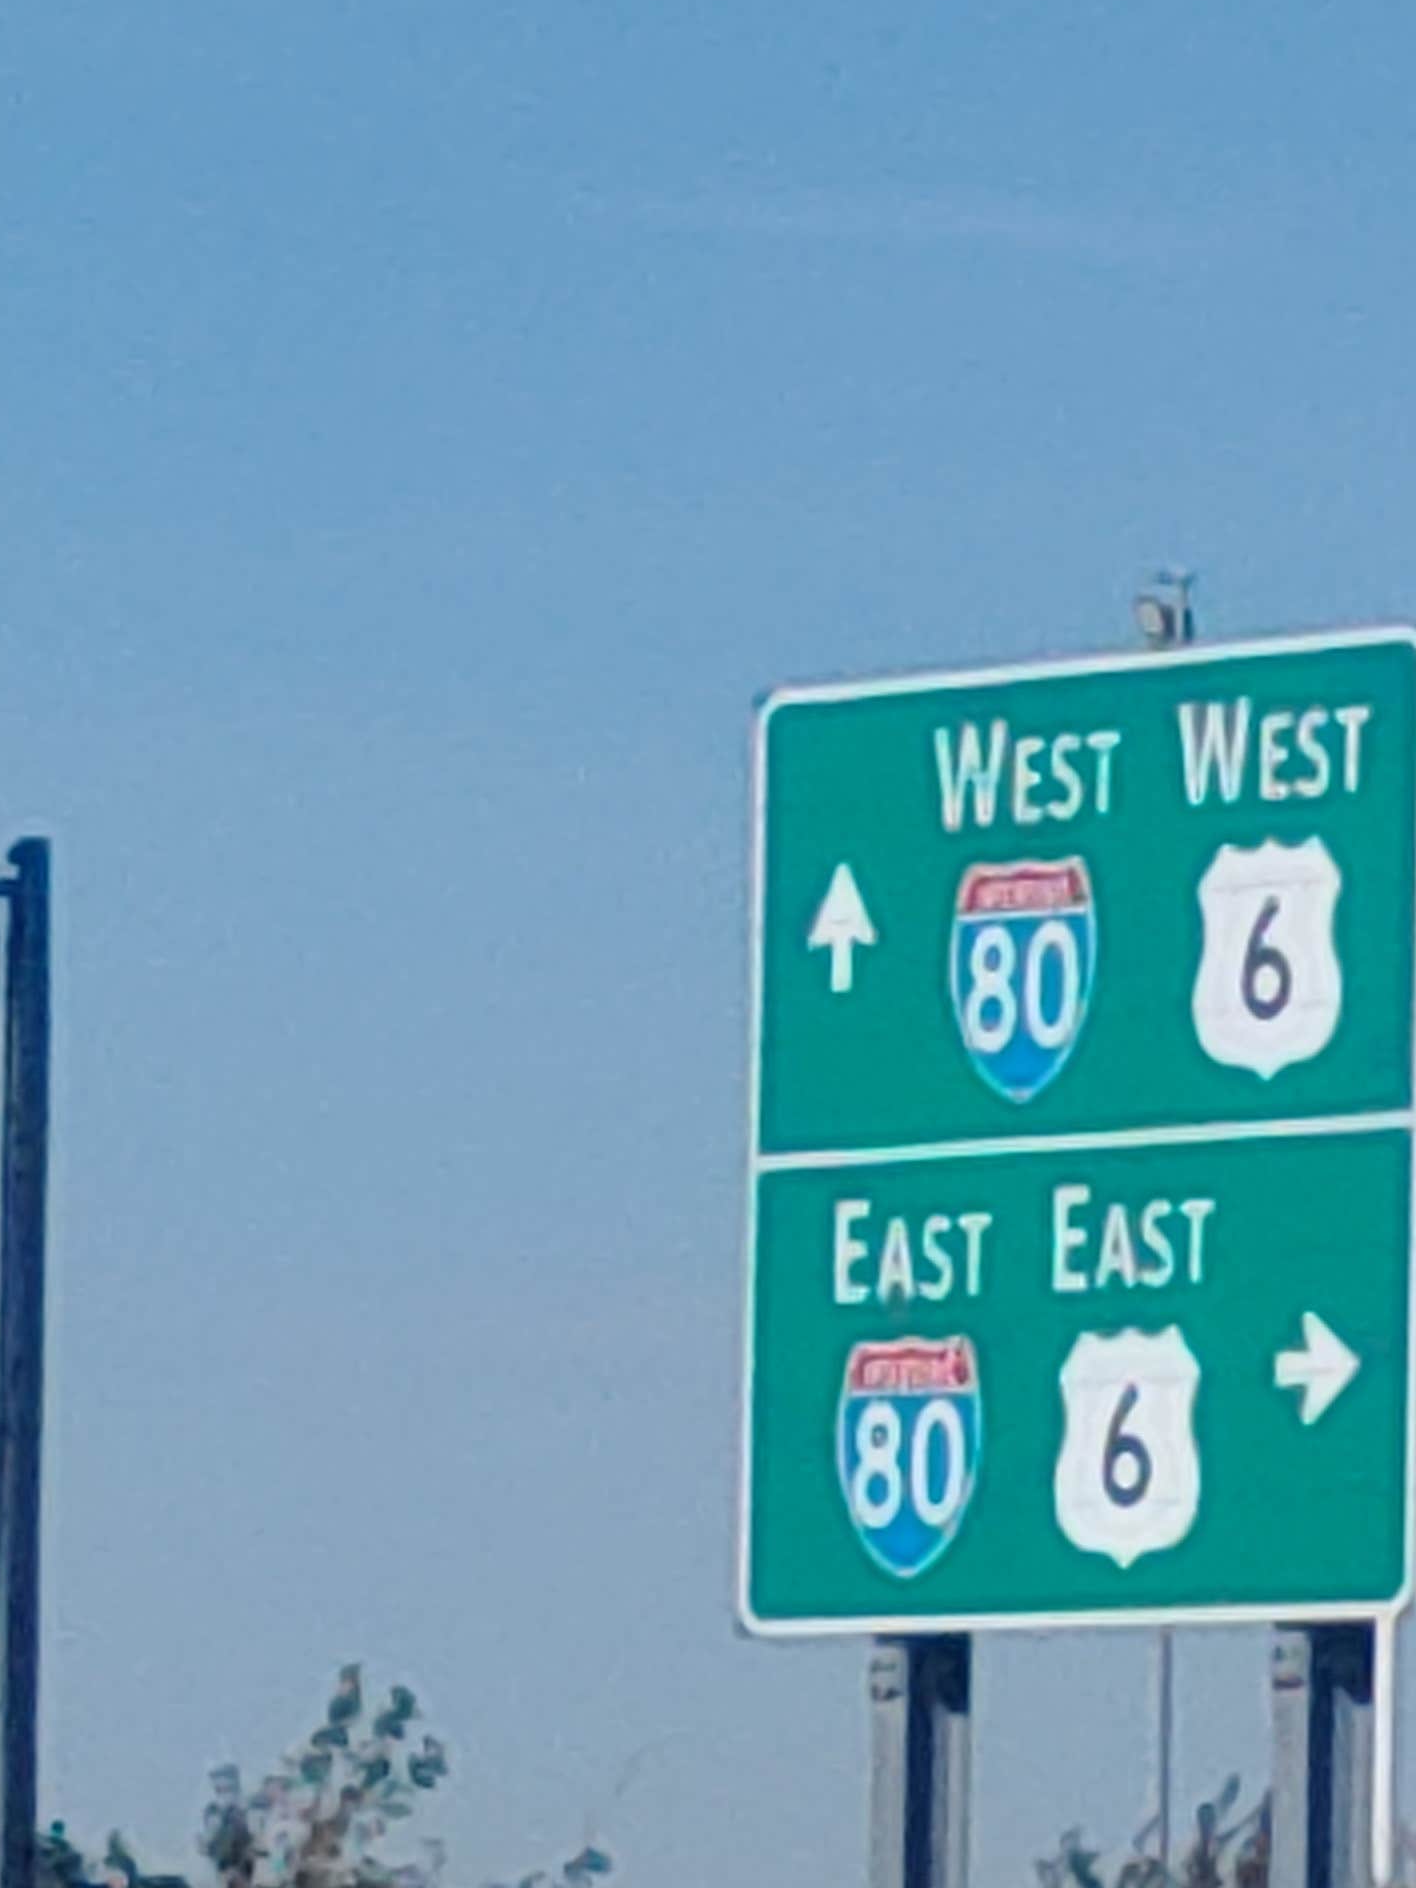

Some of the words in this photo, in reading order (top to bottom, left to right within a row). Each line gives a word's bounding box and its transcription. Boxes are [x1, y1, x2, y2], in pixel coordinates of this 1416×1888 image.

[937, 719, 1120, 831] WEST
[1179, 697, 1371, 805] WEST
[966, 921, 1079, 1053] 80
[1241, 897, 1292, 1021] 6
[834, 1199, 992, 1304] EAST
[1053, 1185, 1215, 1292] EAST
[852, 1399, 967, 1528] 80
[1101, 1383, 1151, 1508] 6
